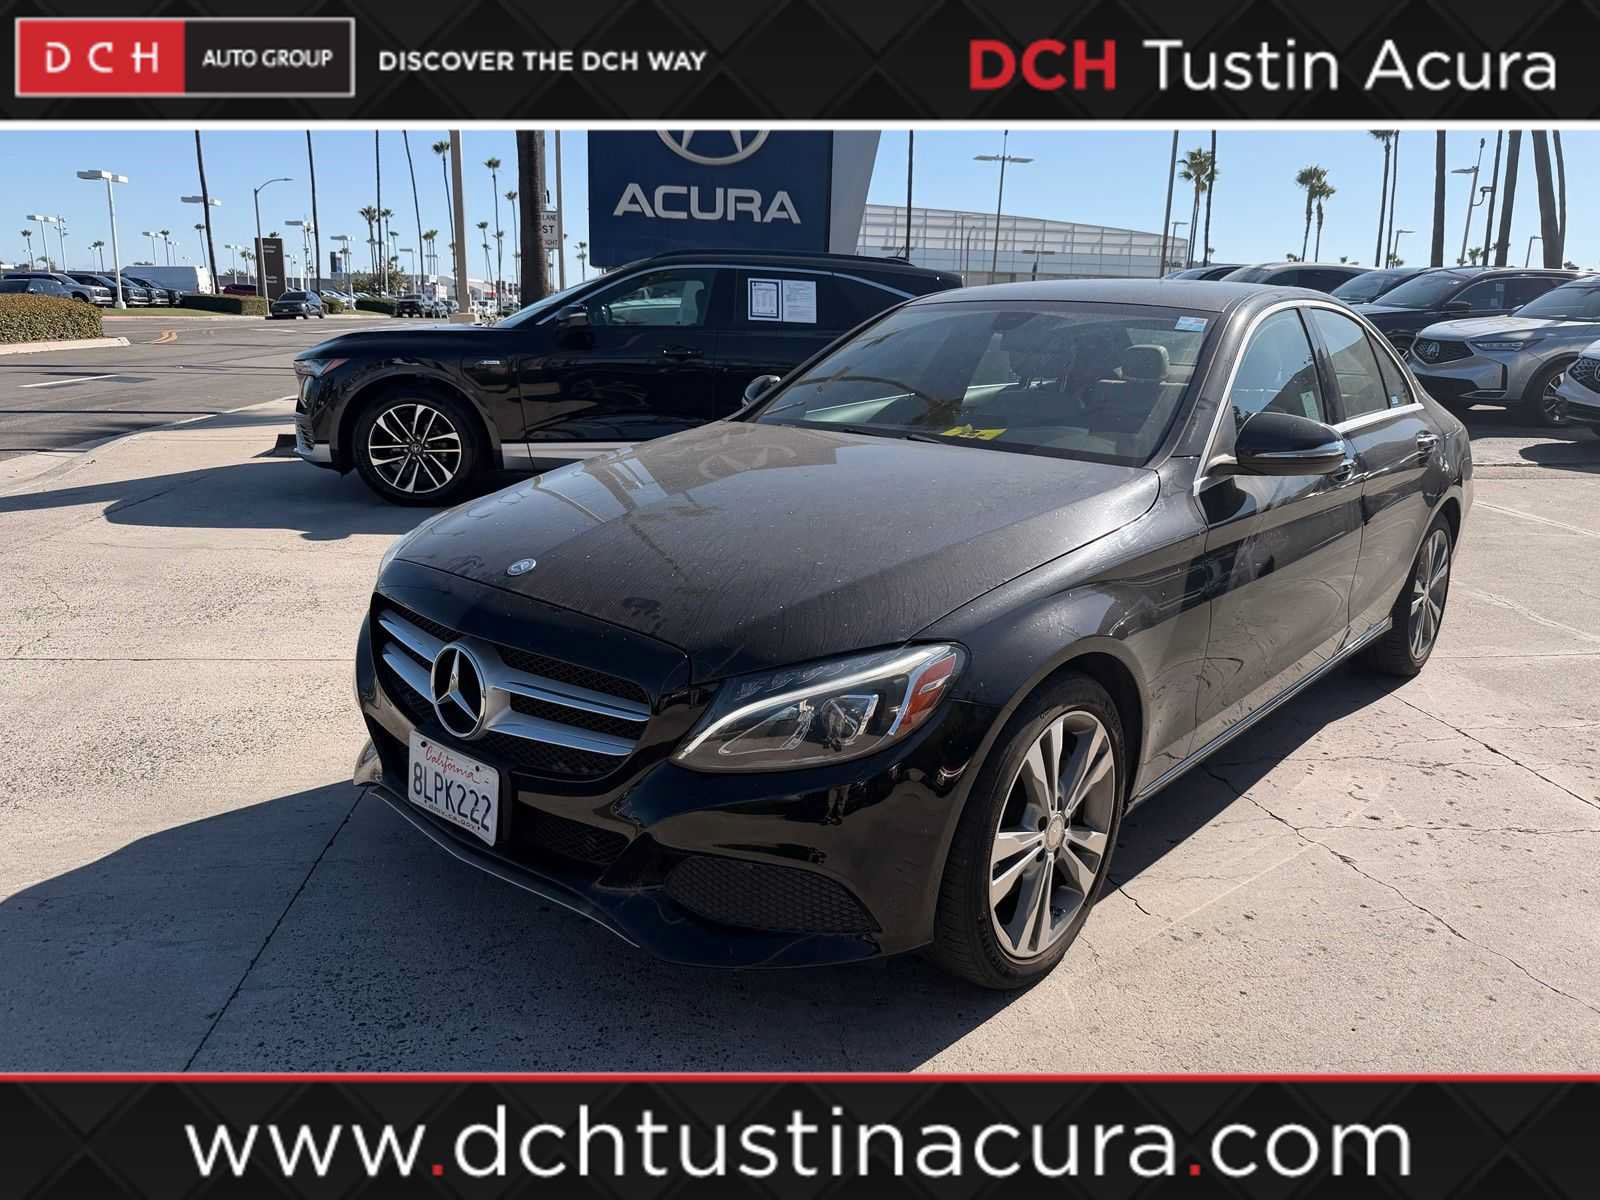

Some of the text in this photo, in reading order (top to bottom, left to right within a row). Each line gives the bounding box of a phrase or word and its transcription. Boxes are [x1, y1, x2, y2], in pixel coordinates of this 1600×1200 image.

[613, 183, 801, 224] ACURA
[425, 744, 480, 785] California
[413, 761, 491, 832] 8LPK222
